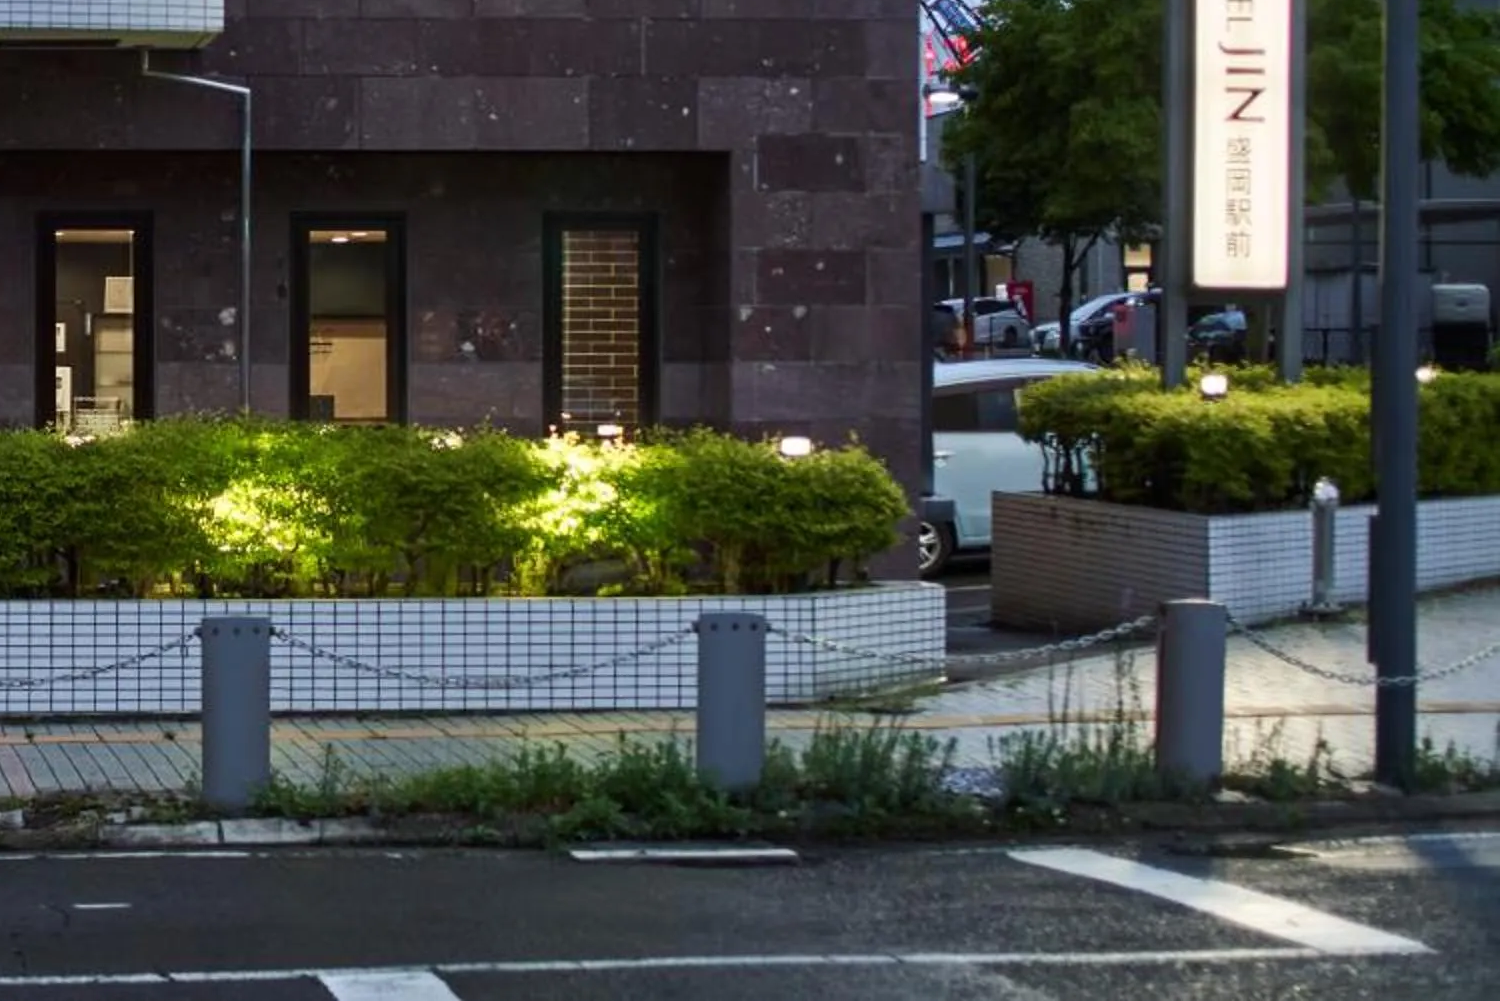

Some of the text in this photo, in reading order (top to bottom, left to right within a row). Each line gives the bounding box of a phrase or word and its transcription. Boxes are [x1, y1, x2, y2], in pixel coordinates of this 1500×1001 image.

[1219, 41, 1266, 123] JIN
[1226, 136, 1252, 258] 盛岡駅前
